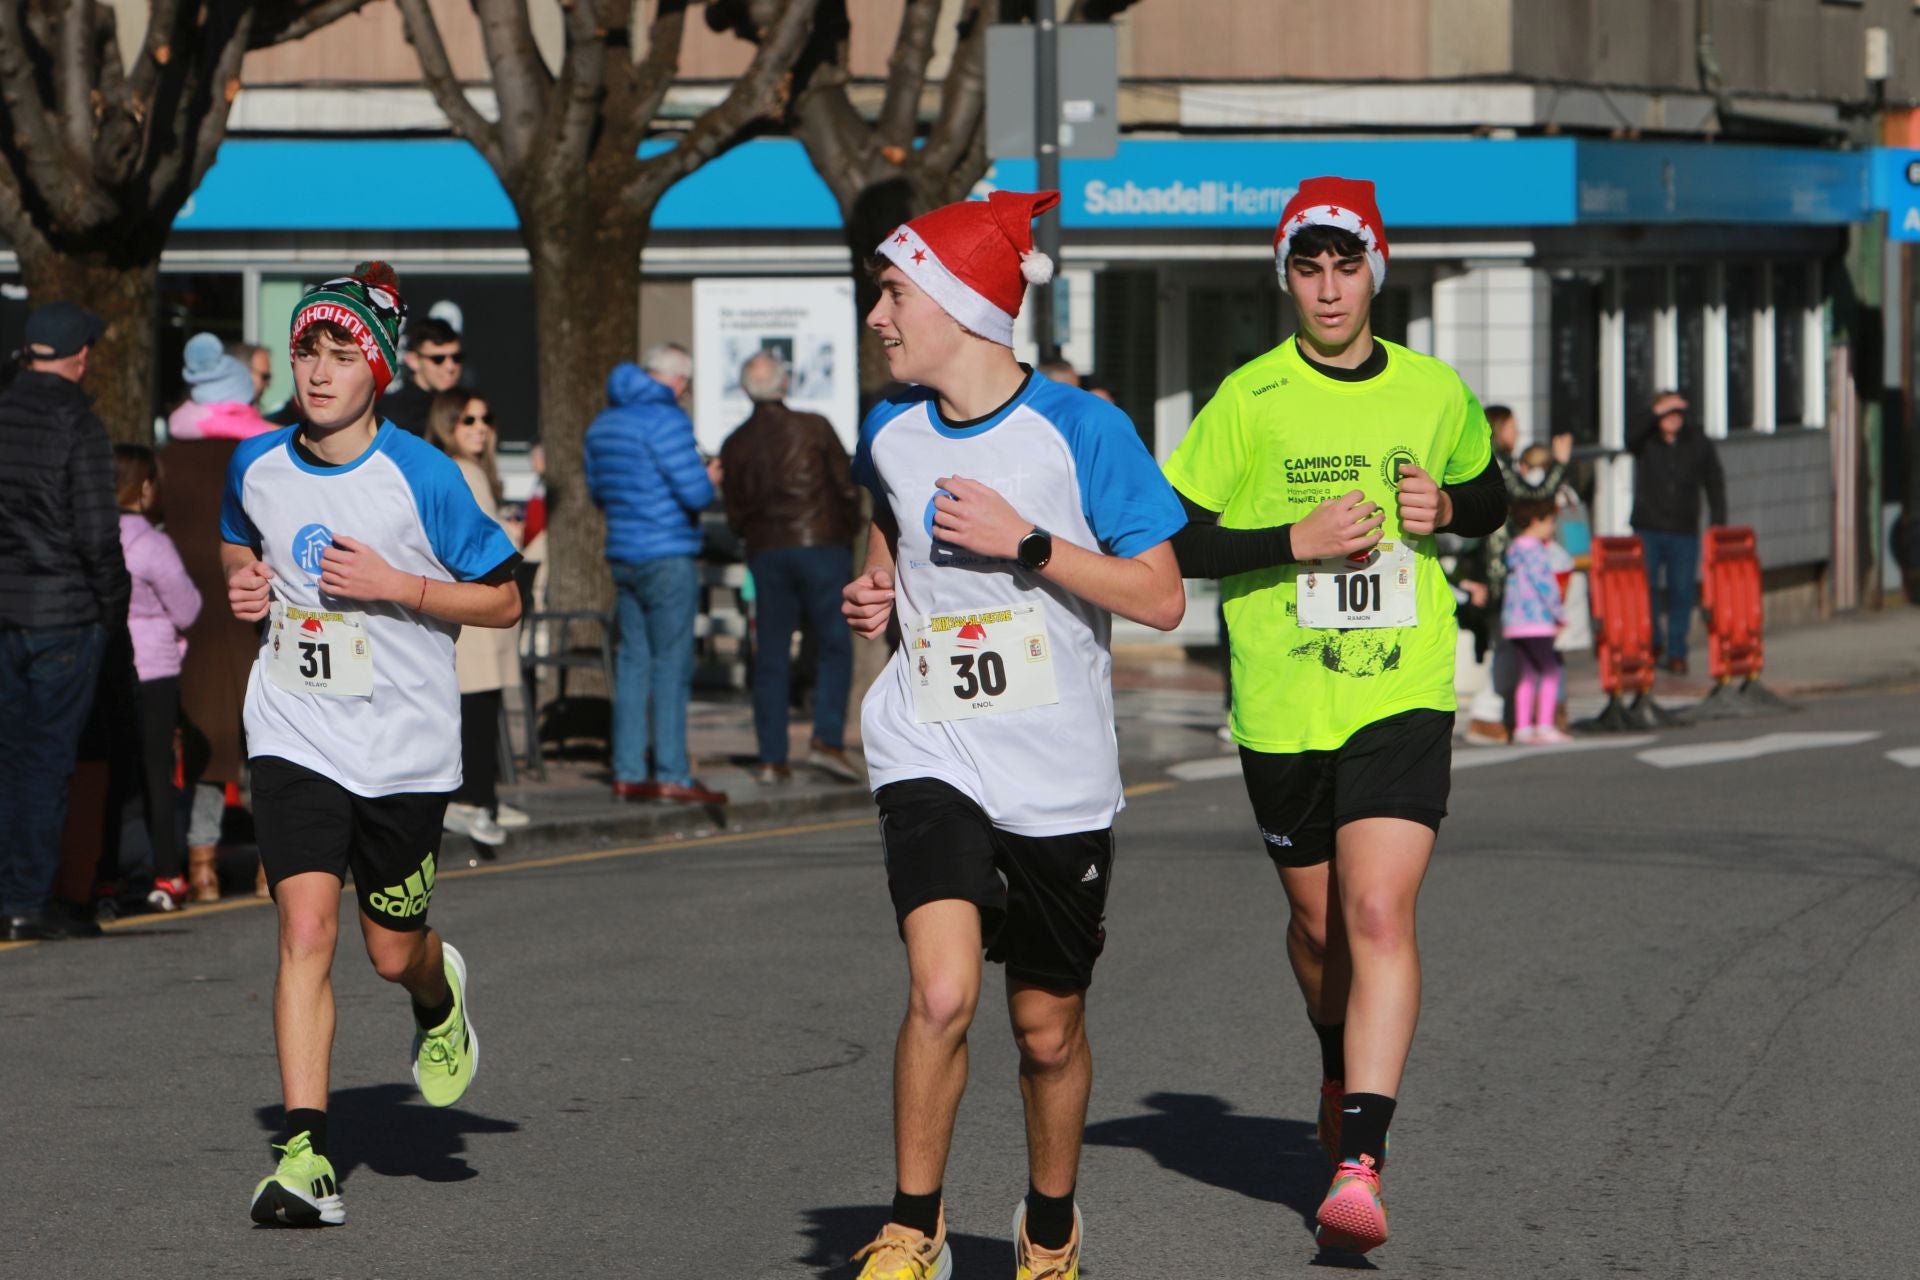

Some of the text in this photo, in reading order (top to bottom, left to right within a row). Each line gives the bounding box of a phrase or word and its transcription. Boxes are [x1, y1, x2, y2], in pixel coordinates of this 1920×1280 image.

[306, 305, 335, 321] HO!
[1251, 380, 1280, 397] luanvi
[1284, 455, 1342, 470] CAMINO
[1344, 455, 1371, 467] DEL
[1286, 469, 1360, 484] SALVADOR
[1287, 487, 1324, 496] Homenaje
[1334, 574, 1381, 612] 101
[298, 641, 331, 680] 31
[950, 651, 1007, 700] 30
[972, 701, 994, 709] ENOL
